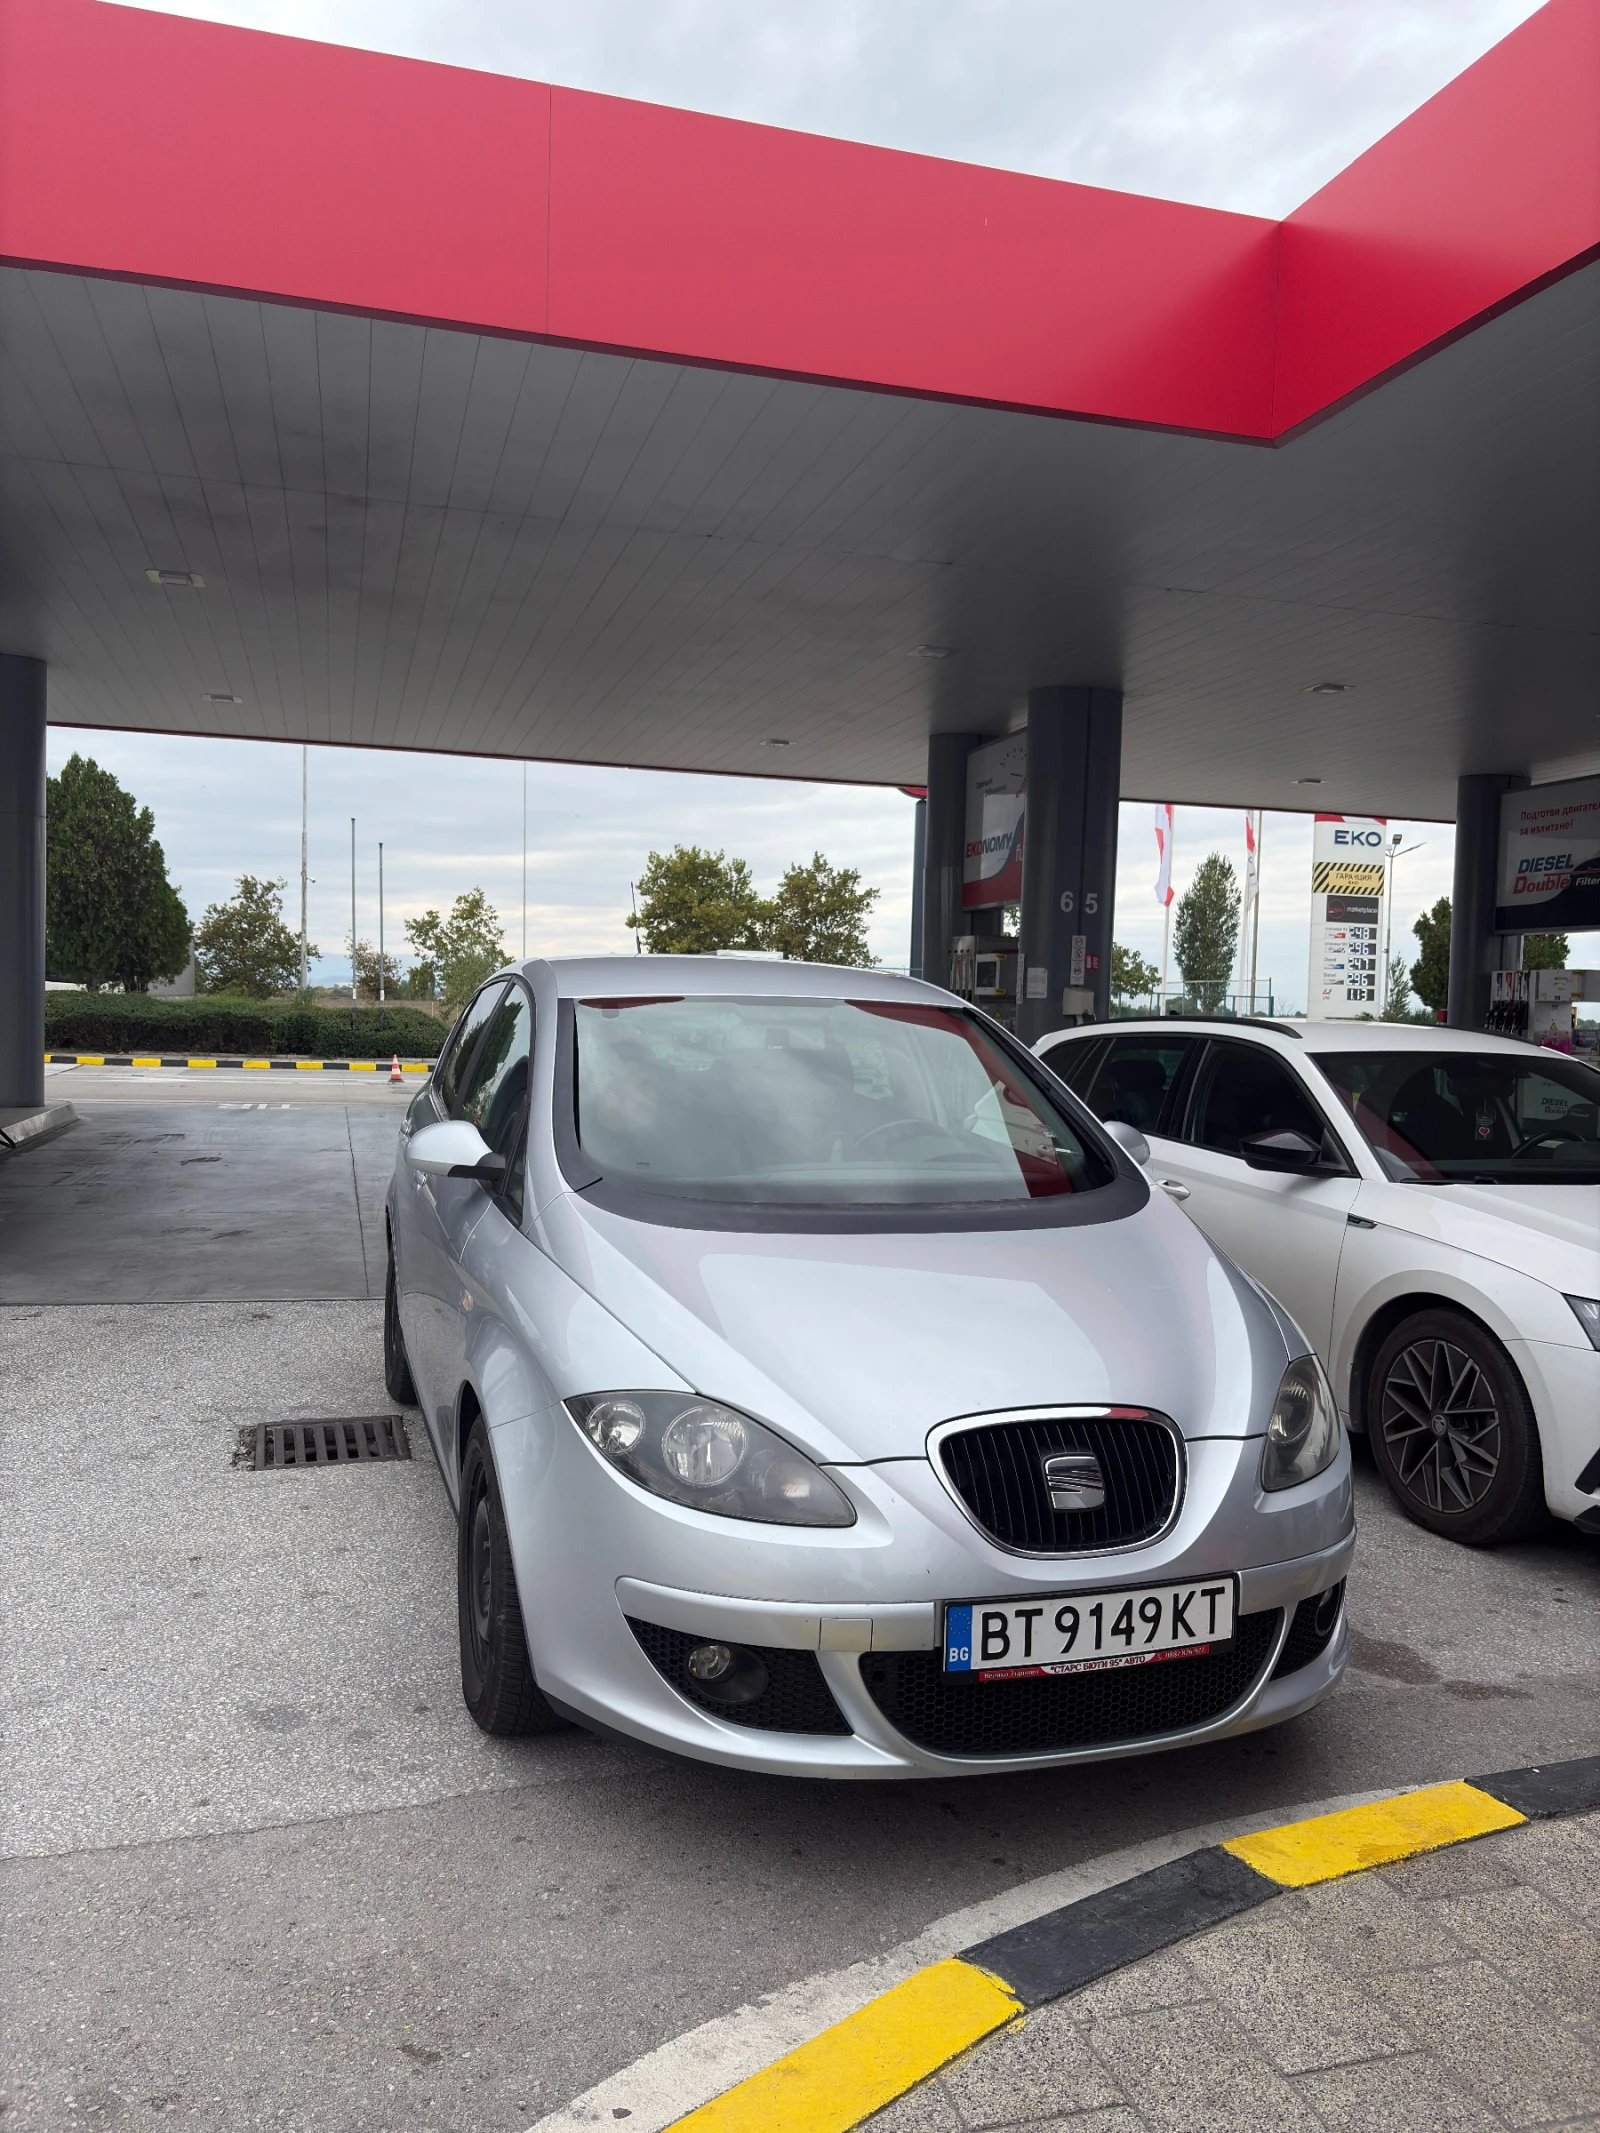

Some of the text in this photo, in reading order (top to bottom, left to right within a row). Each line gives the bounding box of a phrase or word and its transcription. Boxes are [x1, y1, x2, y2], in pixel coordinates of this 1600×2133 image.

[1521, 807, 1560, 822] Подготви
[1519, 820, 1574, 836] за излитане!
[965, 832, 1013, 858] EKONOMY
[1334, 829, 1382, 847] EKO
[1518, 854, 1574, 874] DIESEL
[1335, 873, 1372, 882] ГАРАНЦИЯ
[1513, 875, 1570, 895] Double
[1060, 891, 1098, 914] 6 5
[1346, 906, 1378, 914] marketplace
[949, 1647, 969, 1663] BG
[1083, 1660, 1108, 1670] БЮТИ
[1124, 1655, 1146, 1665] АВТО
